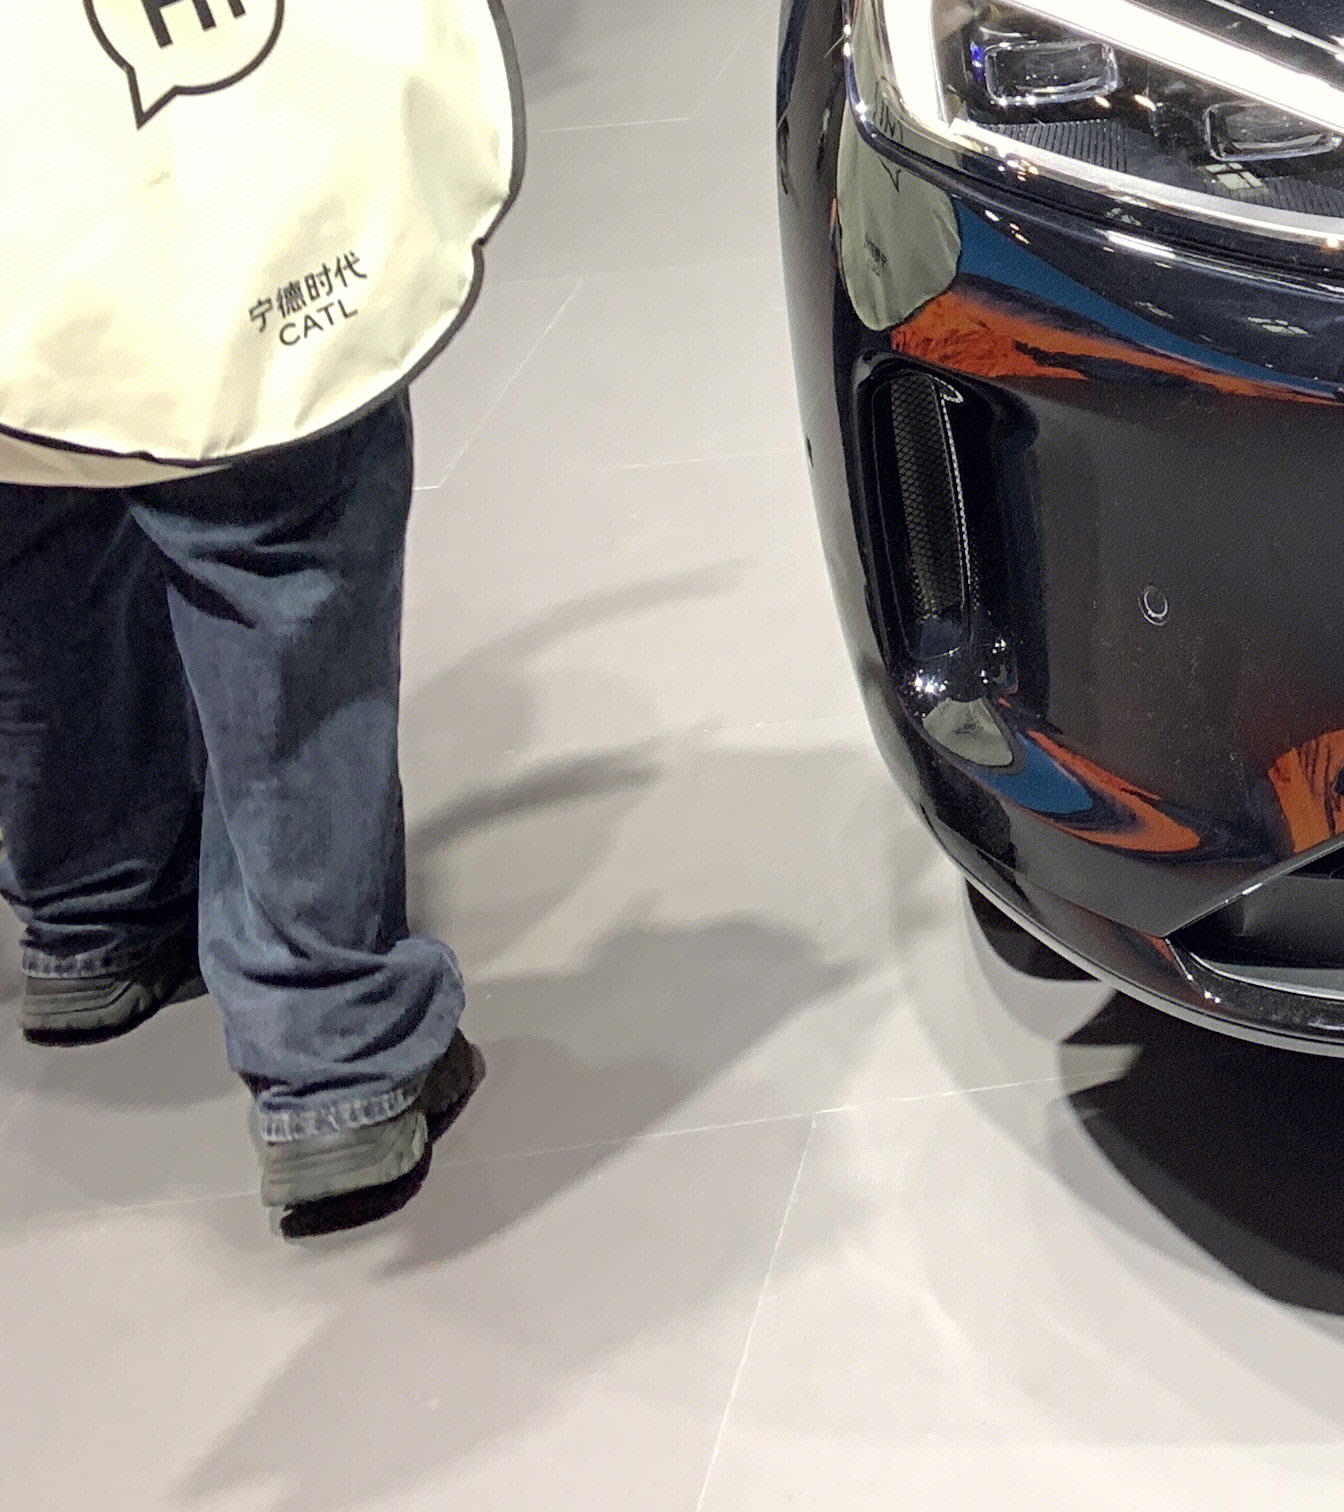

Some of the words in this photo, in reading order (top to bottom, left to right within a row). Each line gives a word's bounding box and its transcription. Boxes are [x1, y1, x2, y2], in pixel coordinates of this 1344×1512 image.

[249, 250, 367, 333] 宁德时代
[279, 299, 358, 346] CATL
